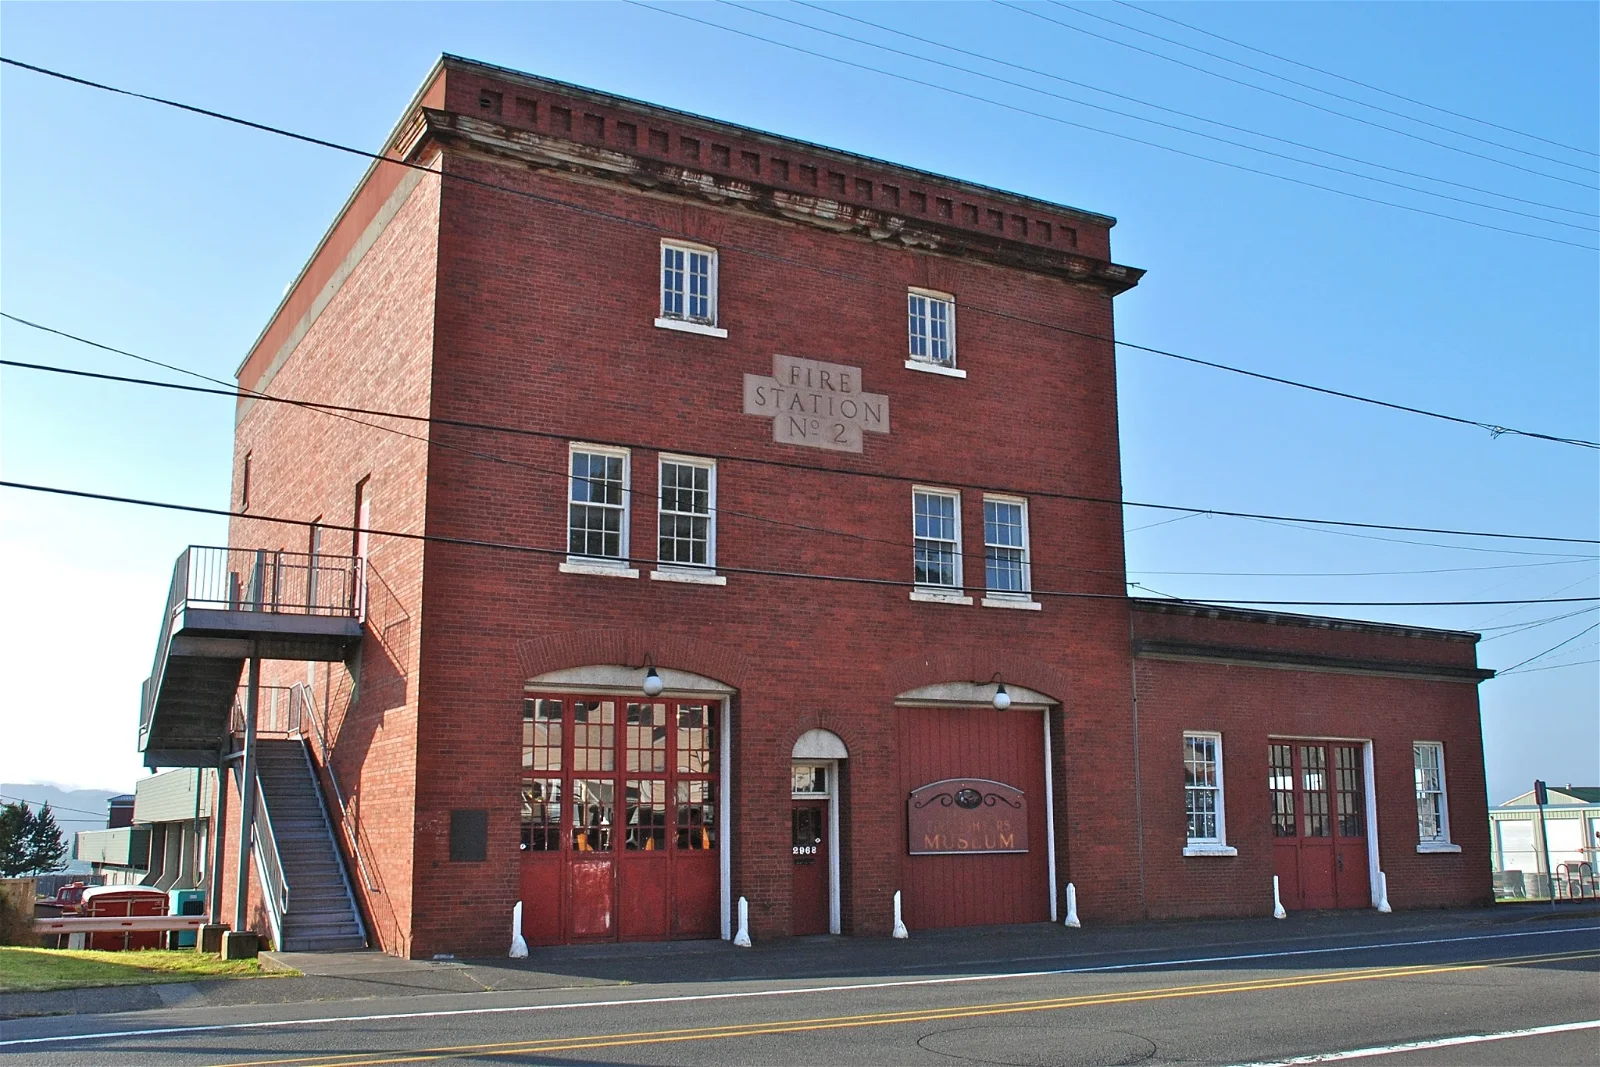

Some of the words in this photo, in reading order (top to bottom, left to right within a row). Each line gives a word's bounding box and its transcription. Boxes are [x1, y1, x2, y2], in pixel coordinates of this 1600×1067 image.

[789, 365, 851, 393] FIRE
[754, 386, 882, 423] STATION
[833, 423, 848, 443] 2
